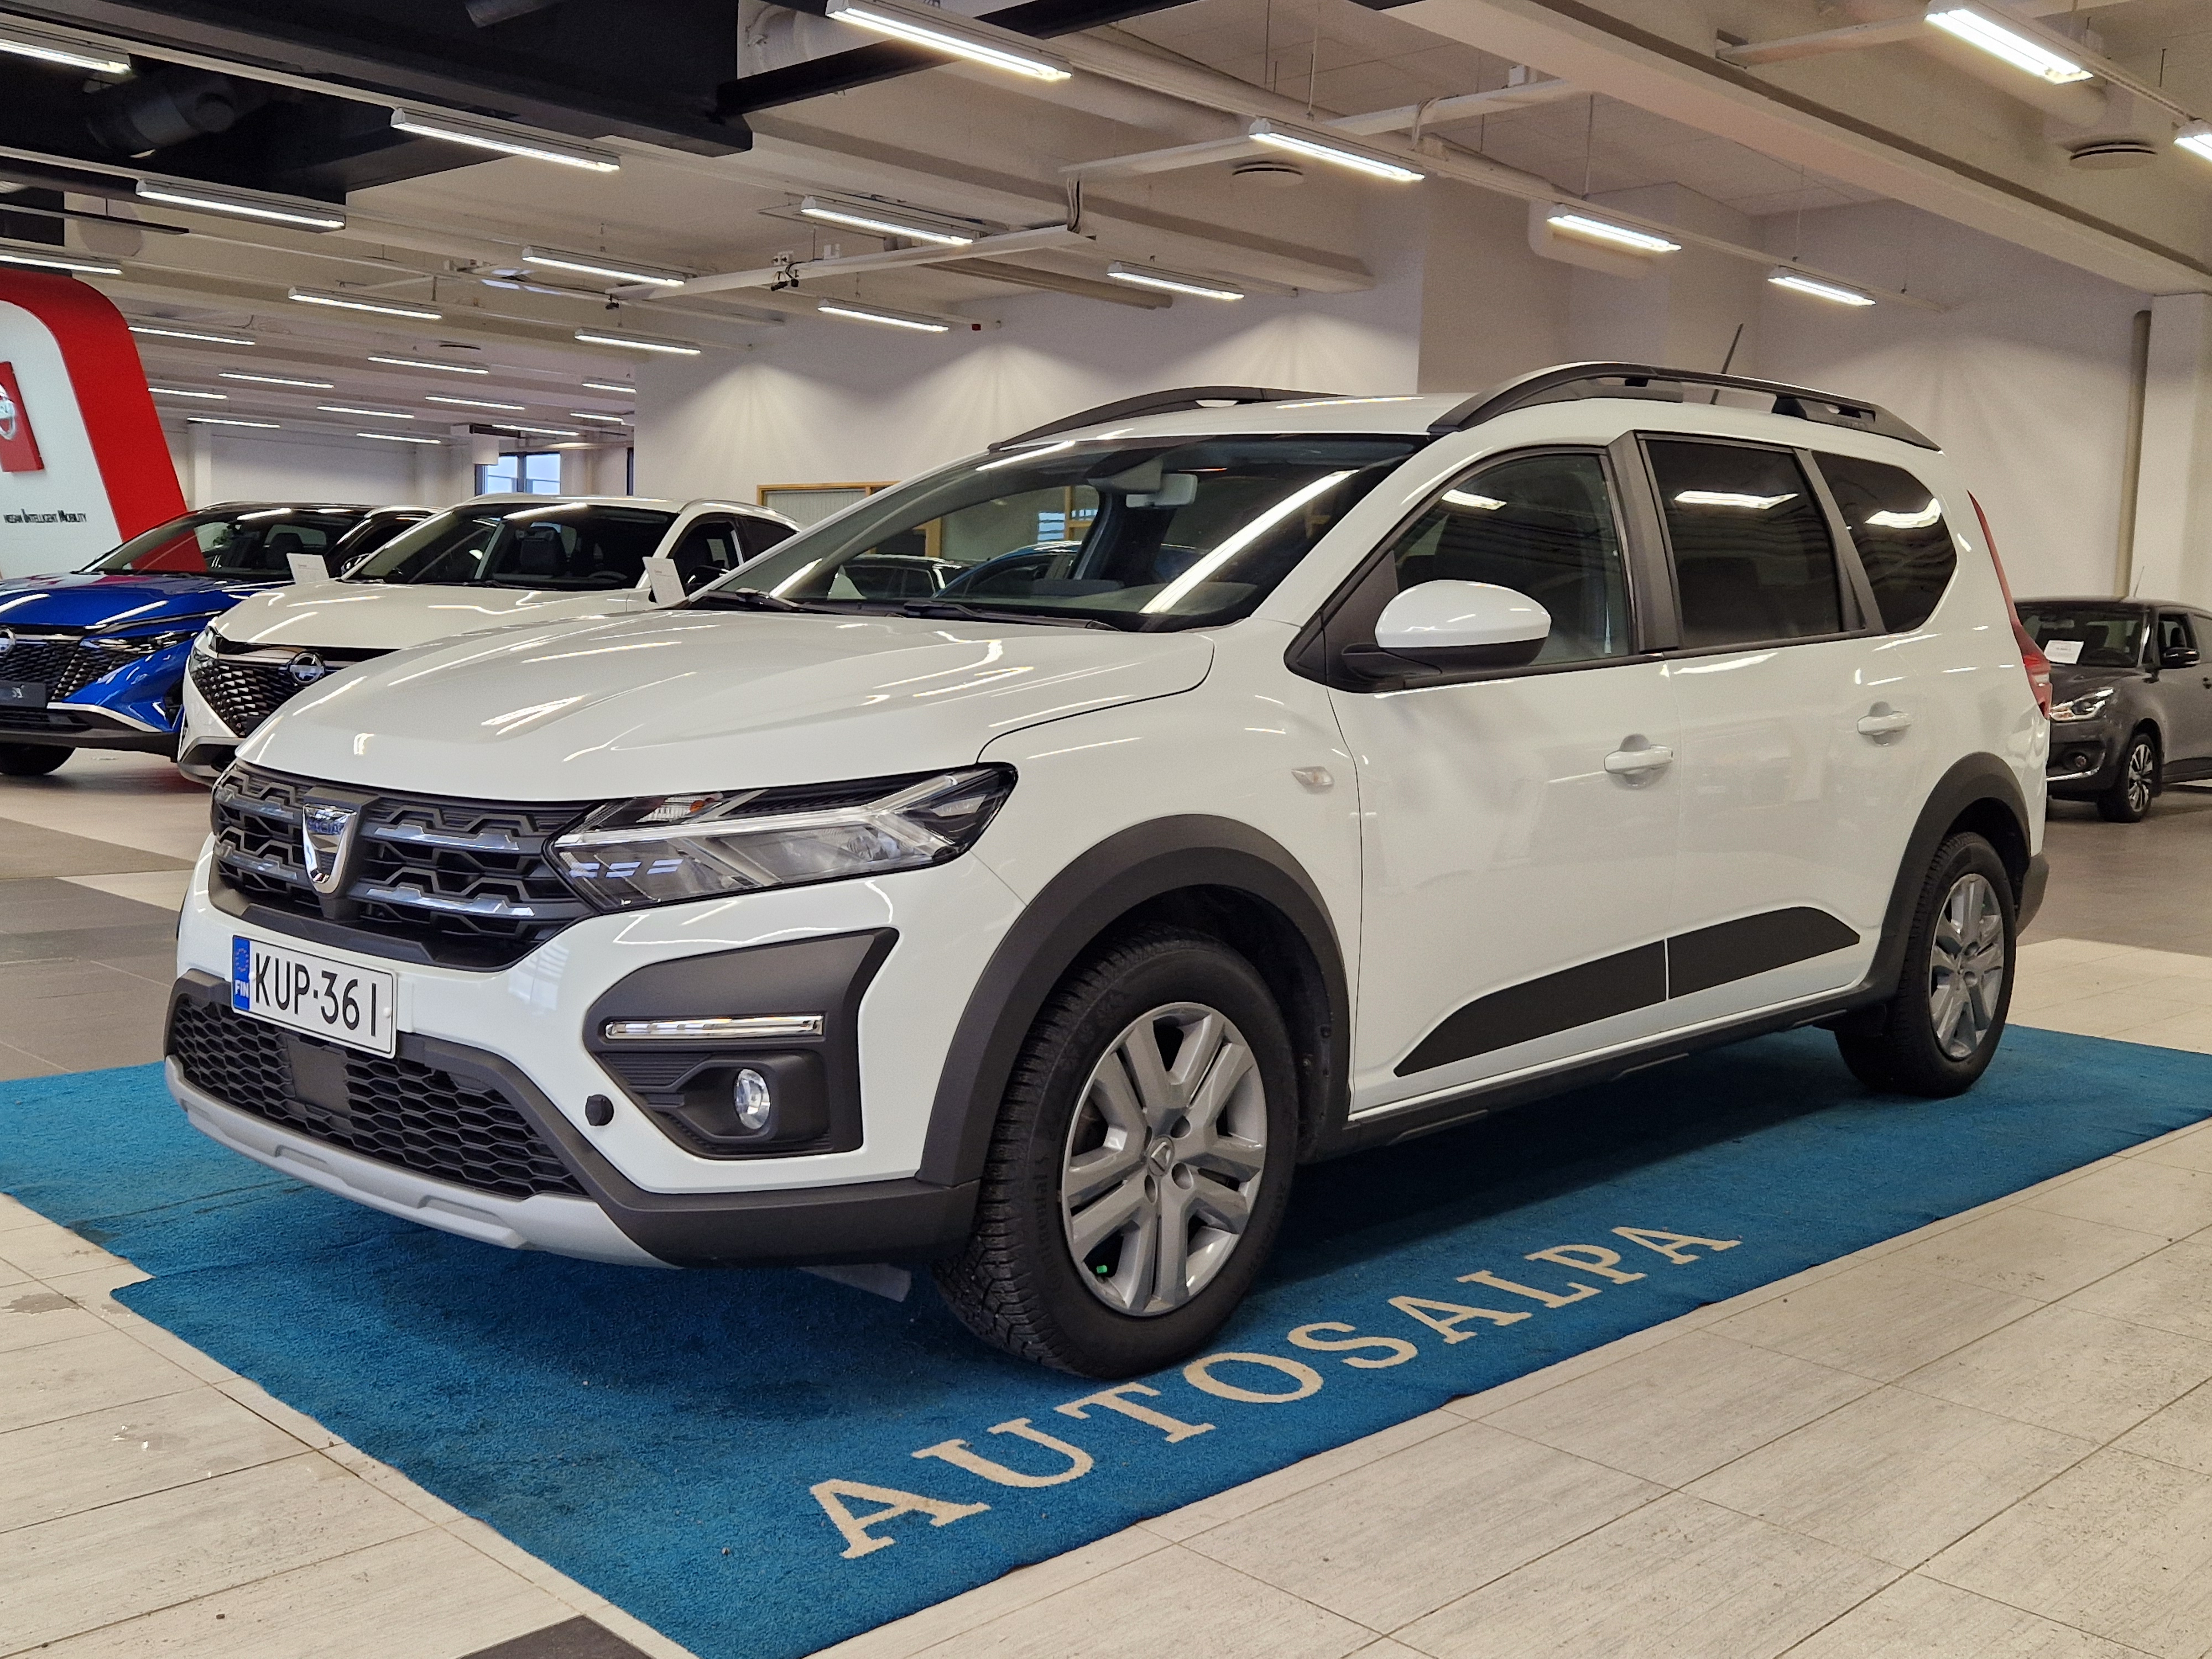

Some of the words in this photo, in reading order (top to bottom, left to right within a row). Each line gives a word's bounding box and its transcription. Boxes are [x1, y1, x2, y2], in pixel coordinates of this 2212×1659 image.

[234, 979, 249, 998] FIN
[255, 952, 377, 1037] KUP-361
[811, 1225, 1741, 1559] AUTOSALPA
